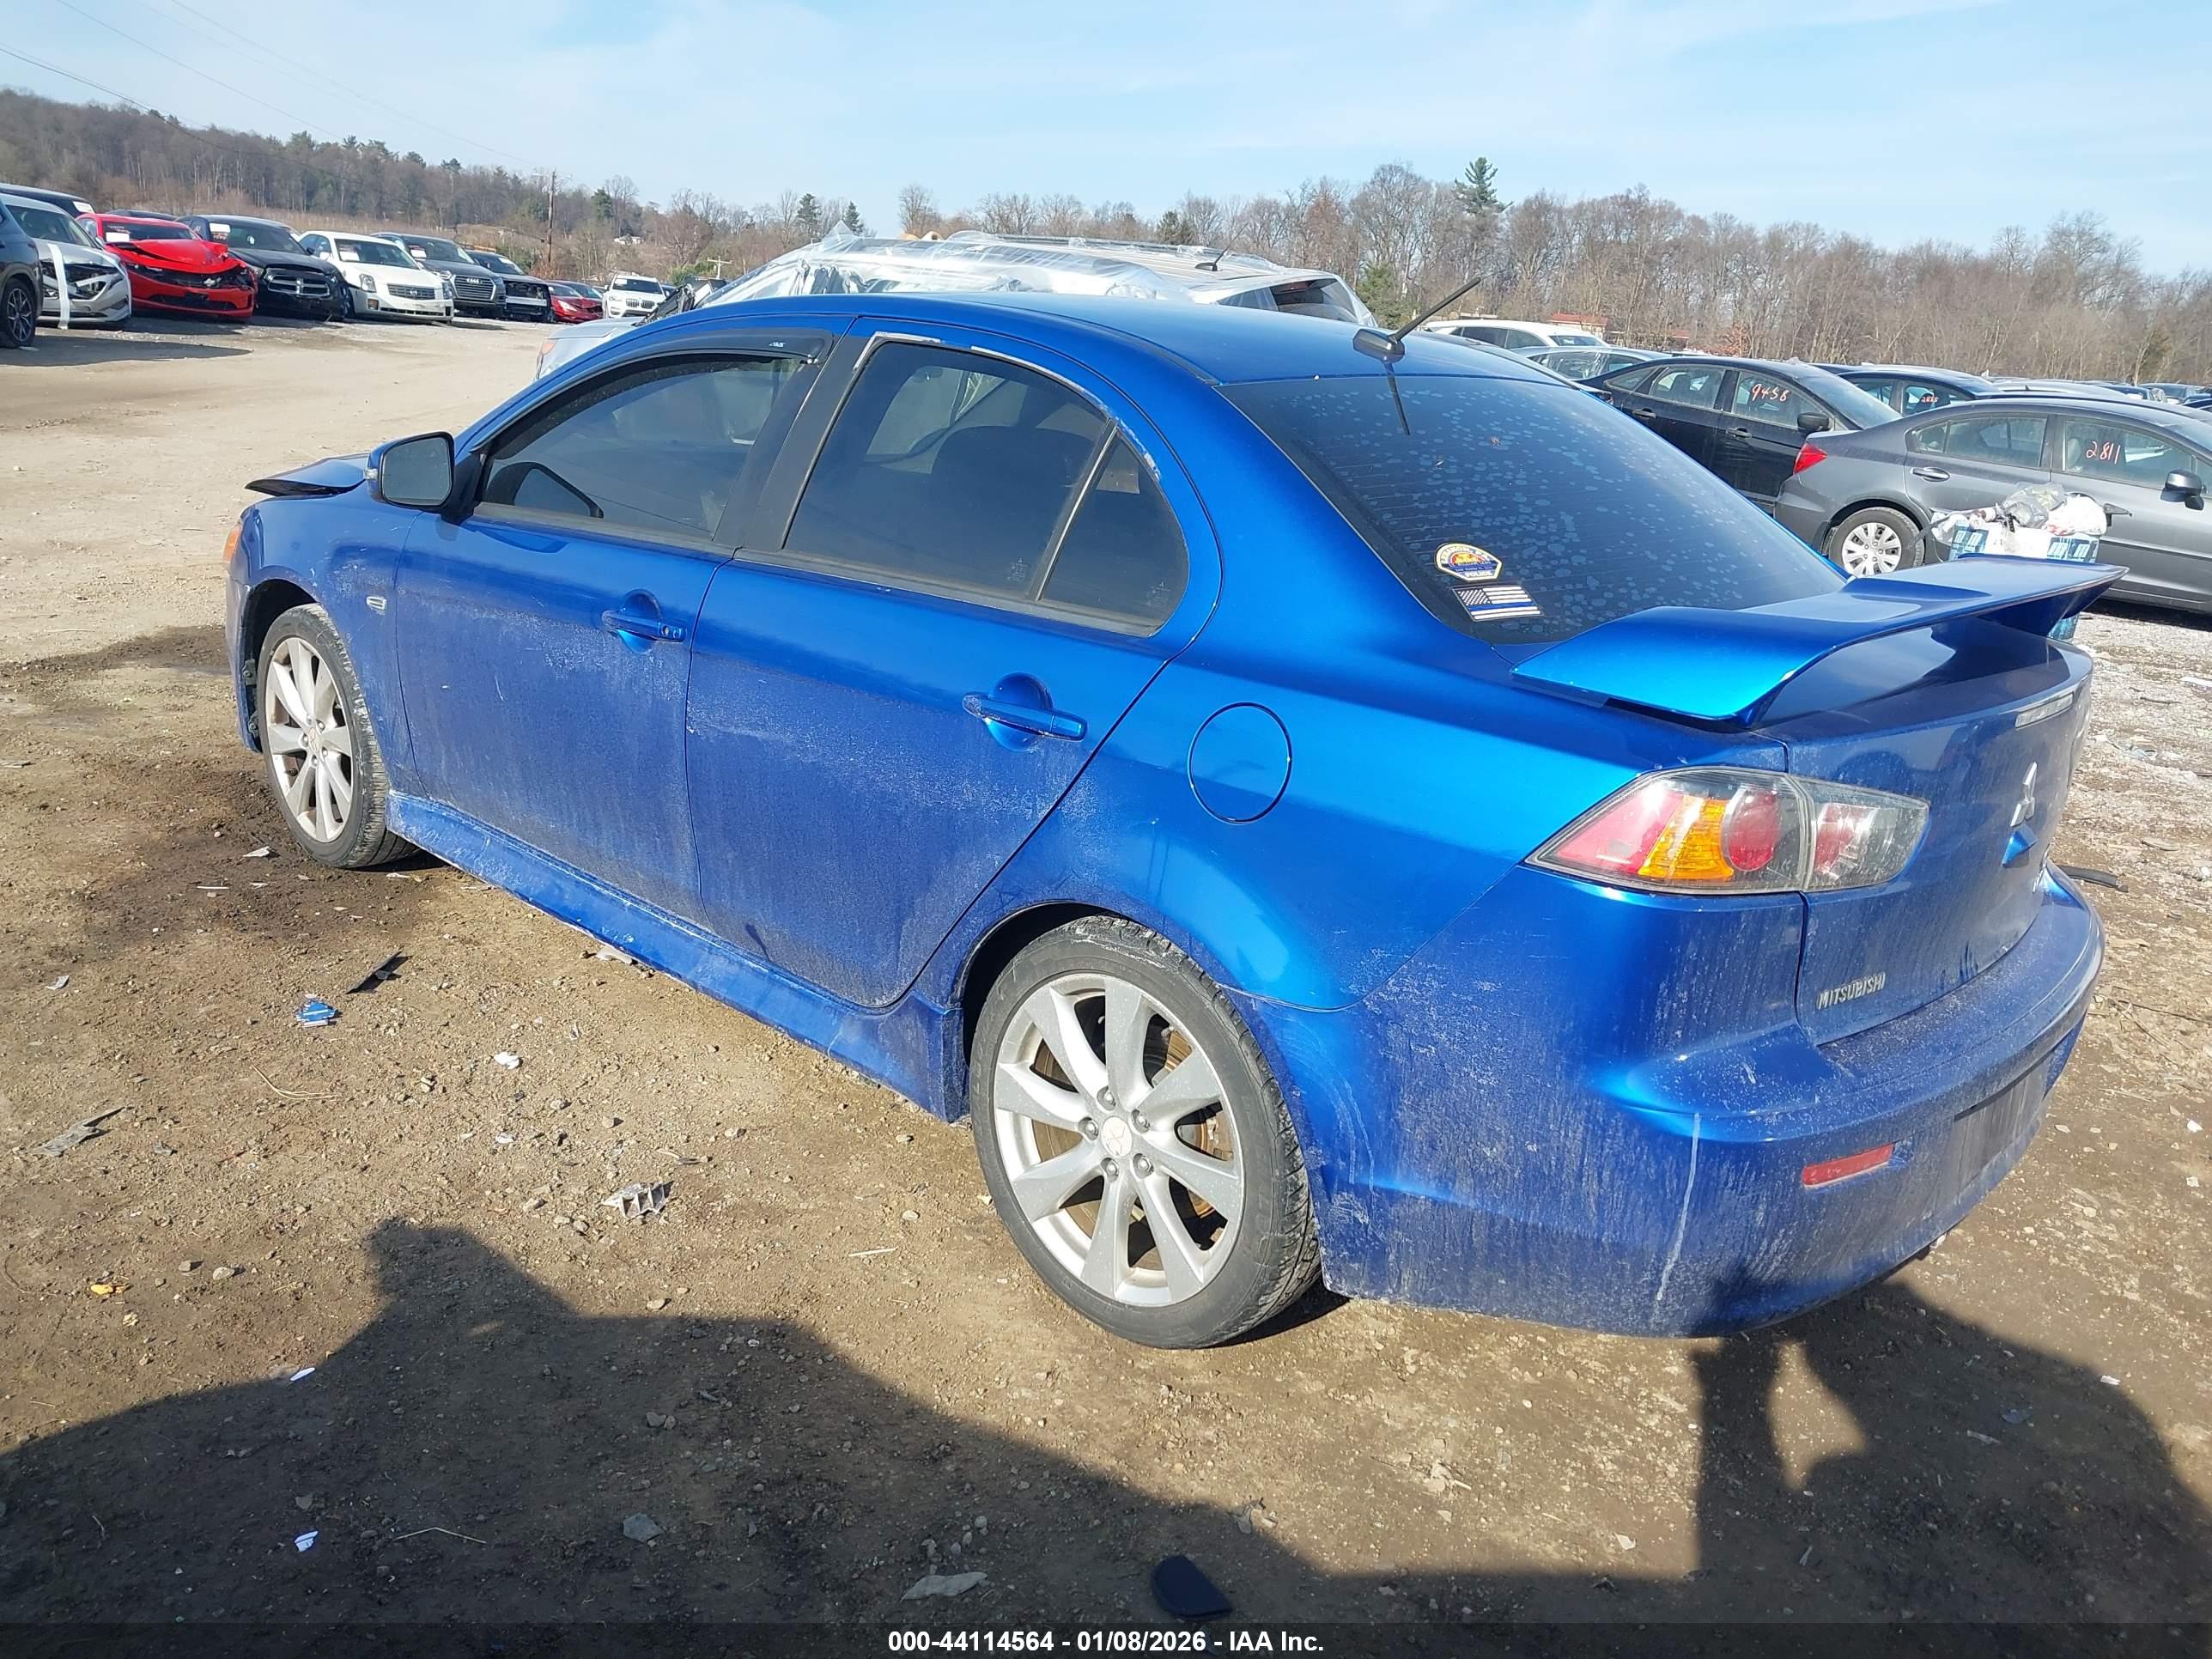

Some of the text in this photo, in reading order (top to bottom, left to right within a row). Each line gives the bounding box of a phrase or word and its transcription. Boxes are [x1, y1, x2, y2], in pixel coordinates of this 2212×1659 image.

[1752, 383, 1790, 401] 9458
[2086, 441, 2121, 465] 2811
[1817, 972, 1887, 1010] MITSUBISHI
